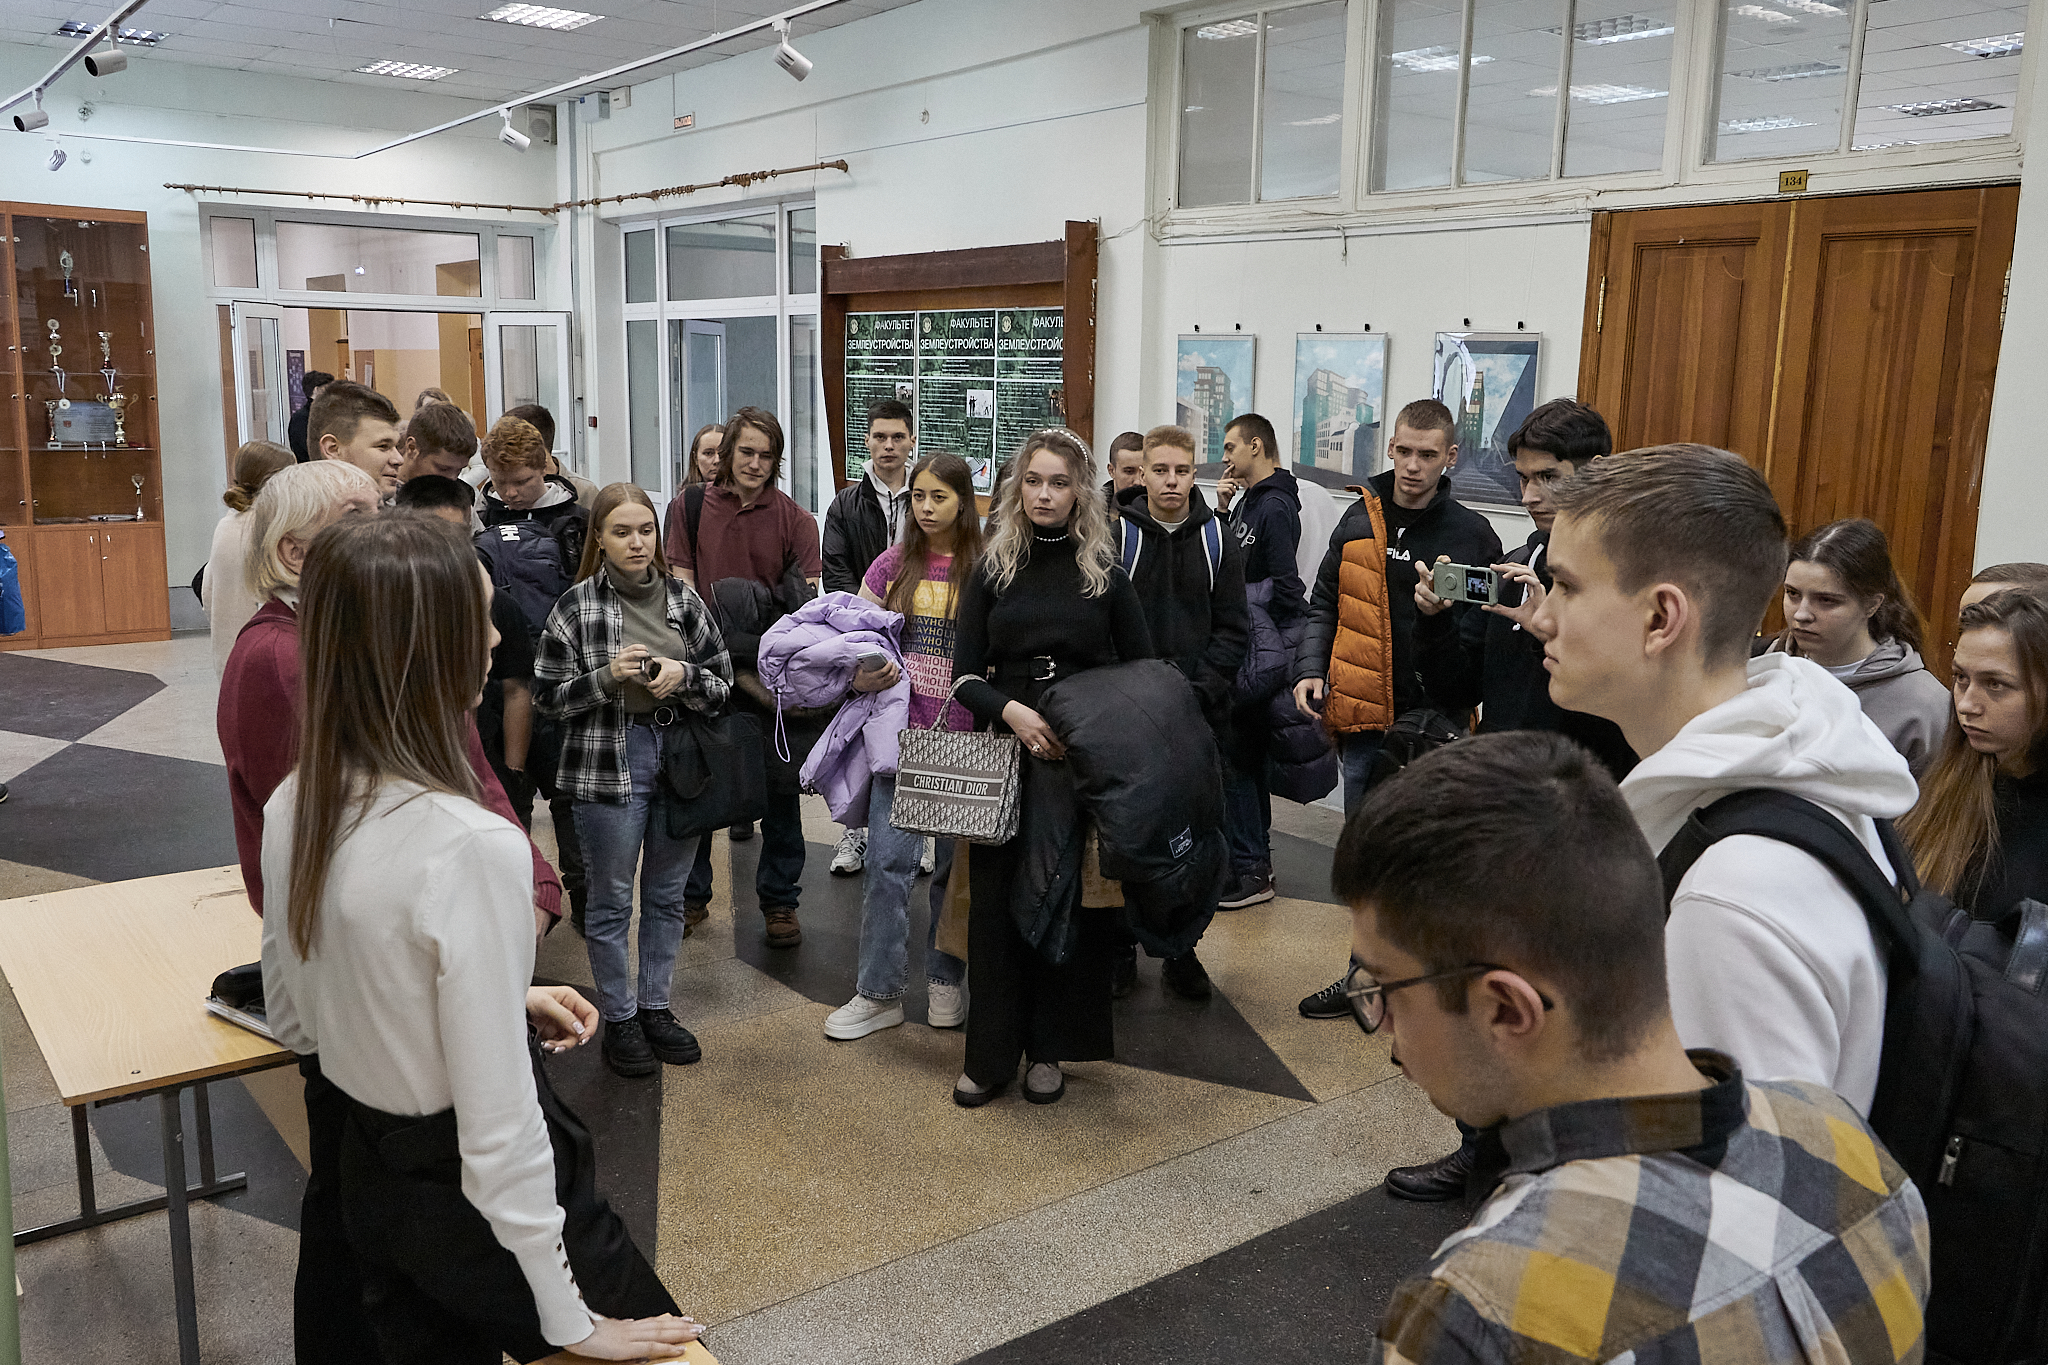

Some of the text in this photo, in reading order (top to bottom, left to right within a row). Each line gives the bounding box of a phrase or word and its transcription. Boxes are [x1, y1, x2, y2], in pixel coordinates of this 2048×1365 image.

[1785, 176, 1802, 186] 134
[875, 319, 914, 330] ФАКУЛЬТЕТ
[950, 317, 994, 329] ФАКУЛЬТЕТ
[847, 337, 914, 350] ЗЕМЛЕУСТРОЙСТВА
[920, 336, 995, 350] ЗЕМЛЕУСТРОЙСТВА
[1386, 547, 1410, 561] FILA
[913, 774, 988, 795] CHRISTIAN DIOR
